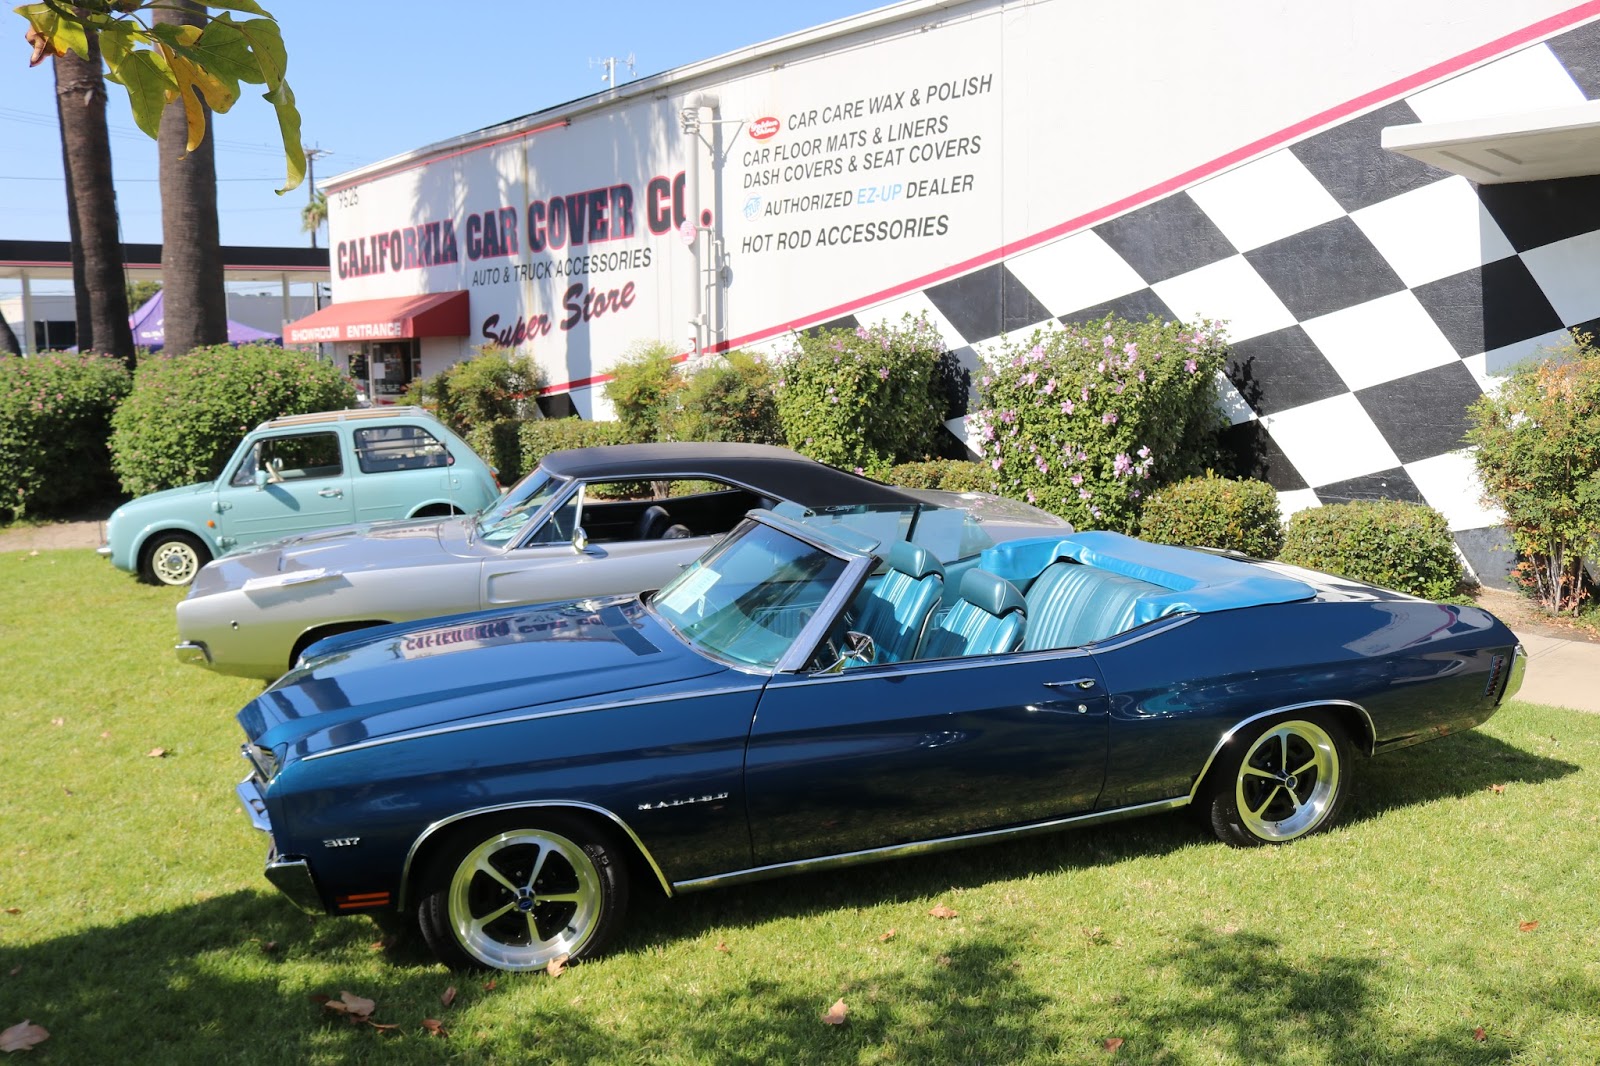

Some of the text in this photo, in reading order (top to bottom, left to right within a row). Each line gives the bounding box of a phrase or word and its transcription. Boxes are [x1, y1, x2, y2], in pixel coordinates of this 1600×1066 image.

[788, 73, 992, 131] CAR CARE WAX & POLISH
[743, 115, 948, 167] CAR FLOOR MATS & LINERS
[743, 136, 982, 189] DASH COVERS & SEAT COVERS
[764, 174, 974, 217] AUTHORIZED EZ-UP DEALER
[337, 219, 458, 280] CALIFORNIA
[466, 206, 519, 261] CAR
[527, 183, 634, 254] COVER
[742, 214, 949, 254] HOT ROD ACCESSORIES
[472, 247, 652, 287] AUTO & TRUCK ACCESSORIES
[291, 322, 401, 341] SHOWROOM ENTRANCE
[482, 280, 636, 348] Super Store
[322, 837, 360, 848] 307
